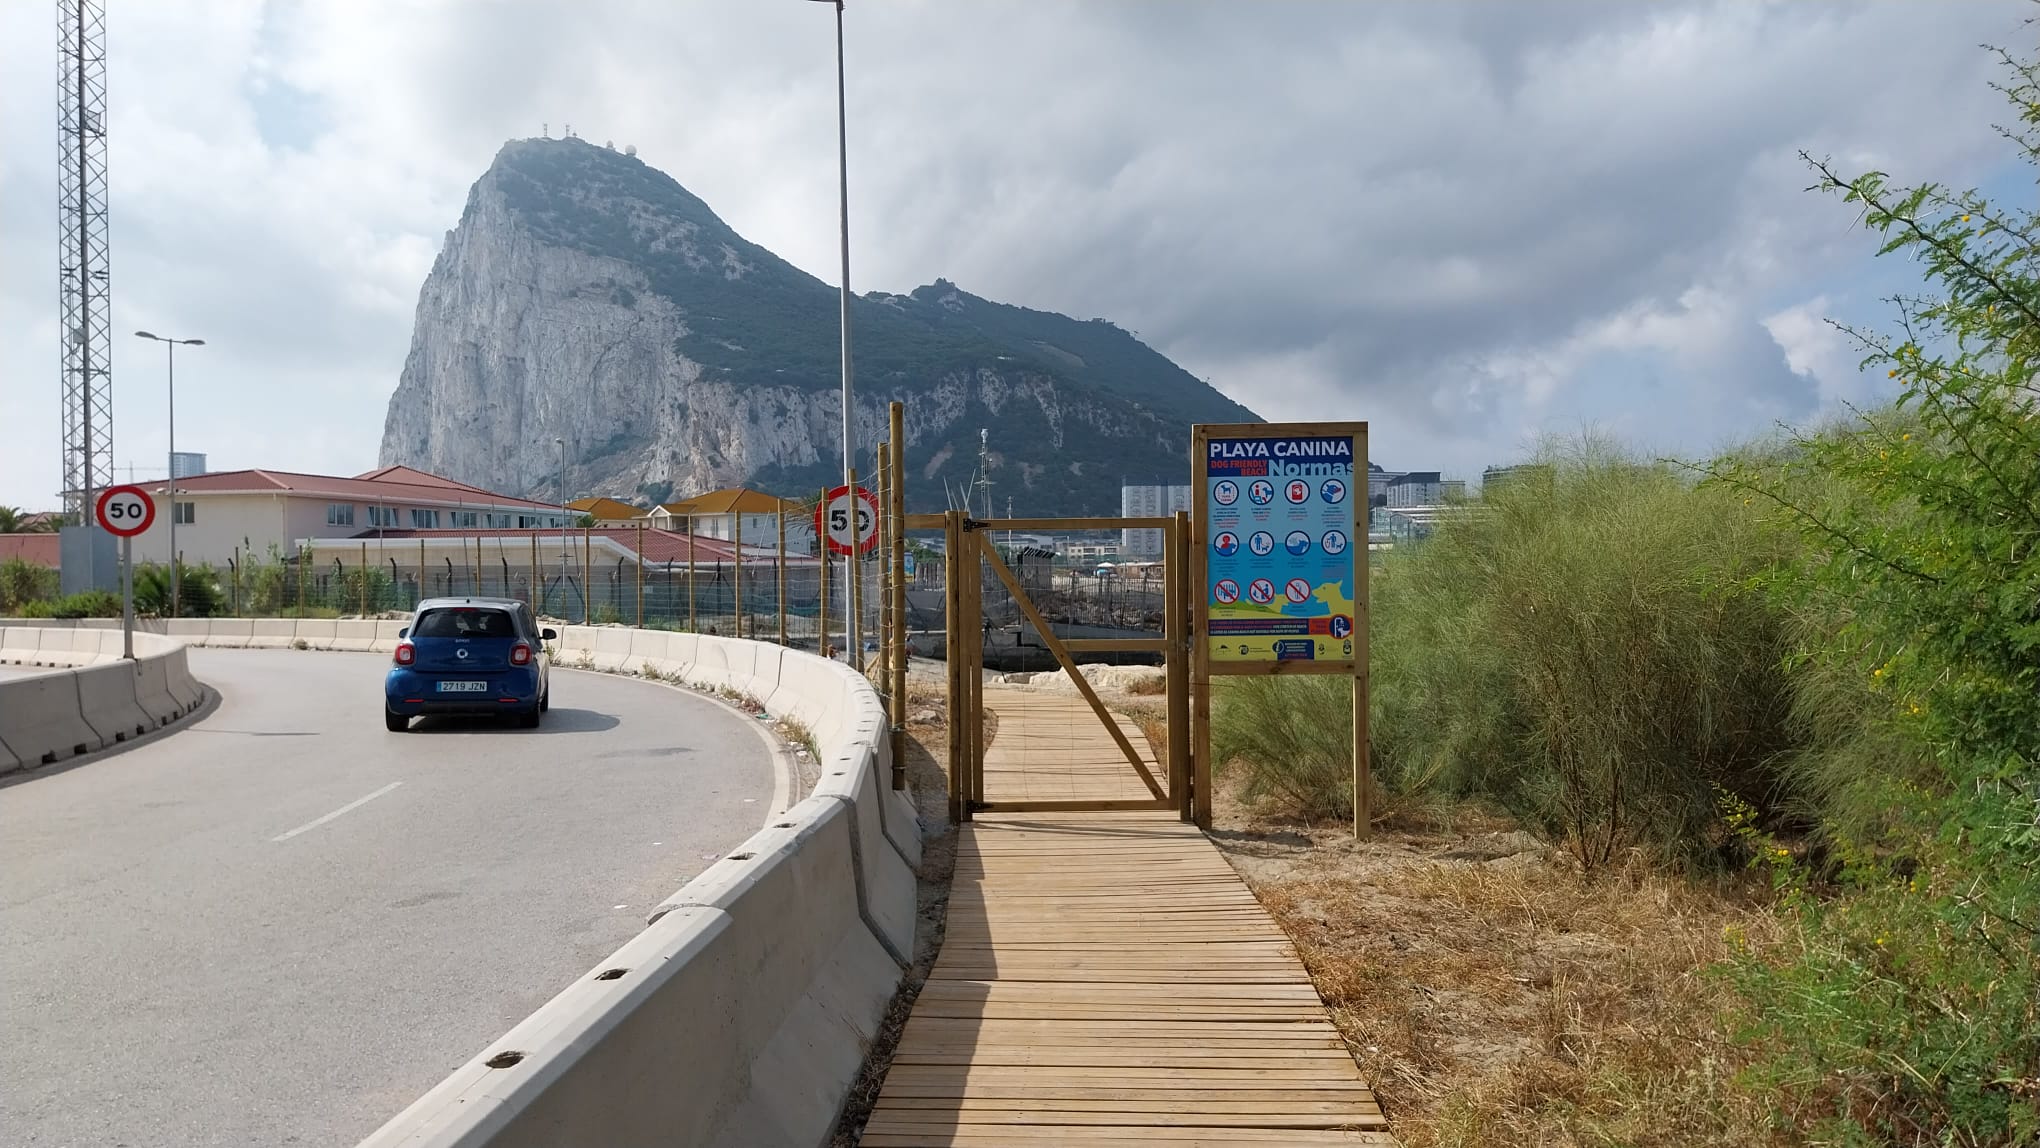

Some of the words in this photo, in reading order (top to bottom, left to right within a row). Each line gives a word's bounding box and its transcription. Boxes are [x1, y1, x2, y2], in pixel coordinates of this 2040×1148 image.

[1210, 442, 1269, 457] PLAYA
[1273, 441, 1350, 456] CANINA
[1211, 460, 1228, 469] DOG
[1230, 459, 1267, 468] FRIENDLY
[1241, 467, 1267, 476] BEACH
[111, 502, 142, 519] 50
[443, 682, 466, 691] 2719
[468, 682, 486, 691] JZN
